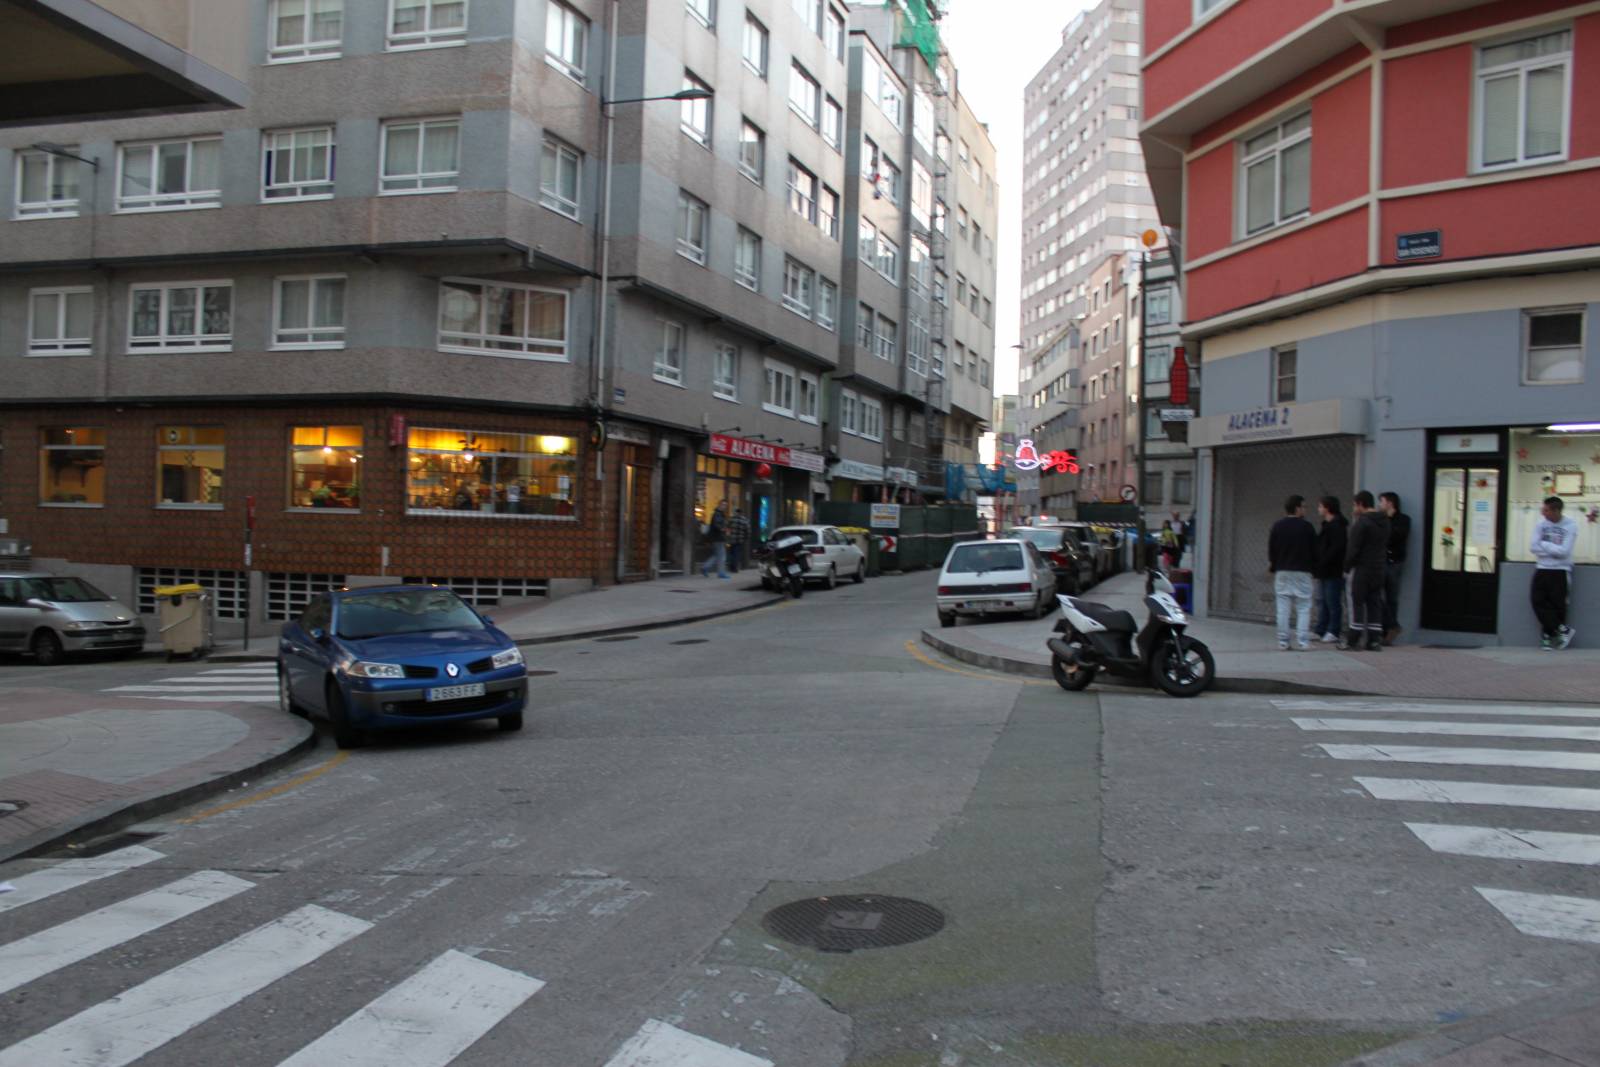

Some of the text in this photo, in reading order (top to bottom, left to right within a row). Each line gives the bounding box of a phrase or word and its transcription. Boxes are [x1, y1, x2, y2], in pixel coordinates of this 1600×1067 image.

[1228, 408, 1290, 431] ALACENA 2
[731, 440, 775, 461] ALACENA
